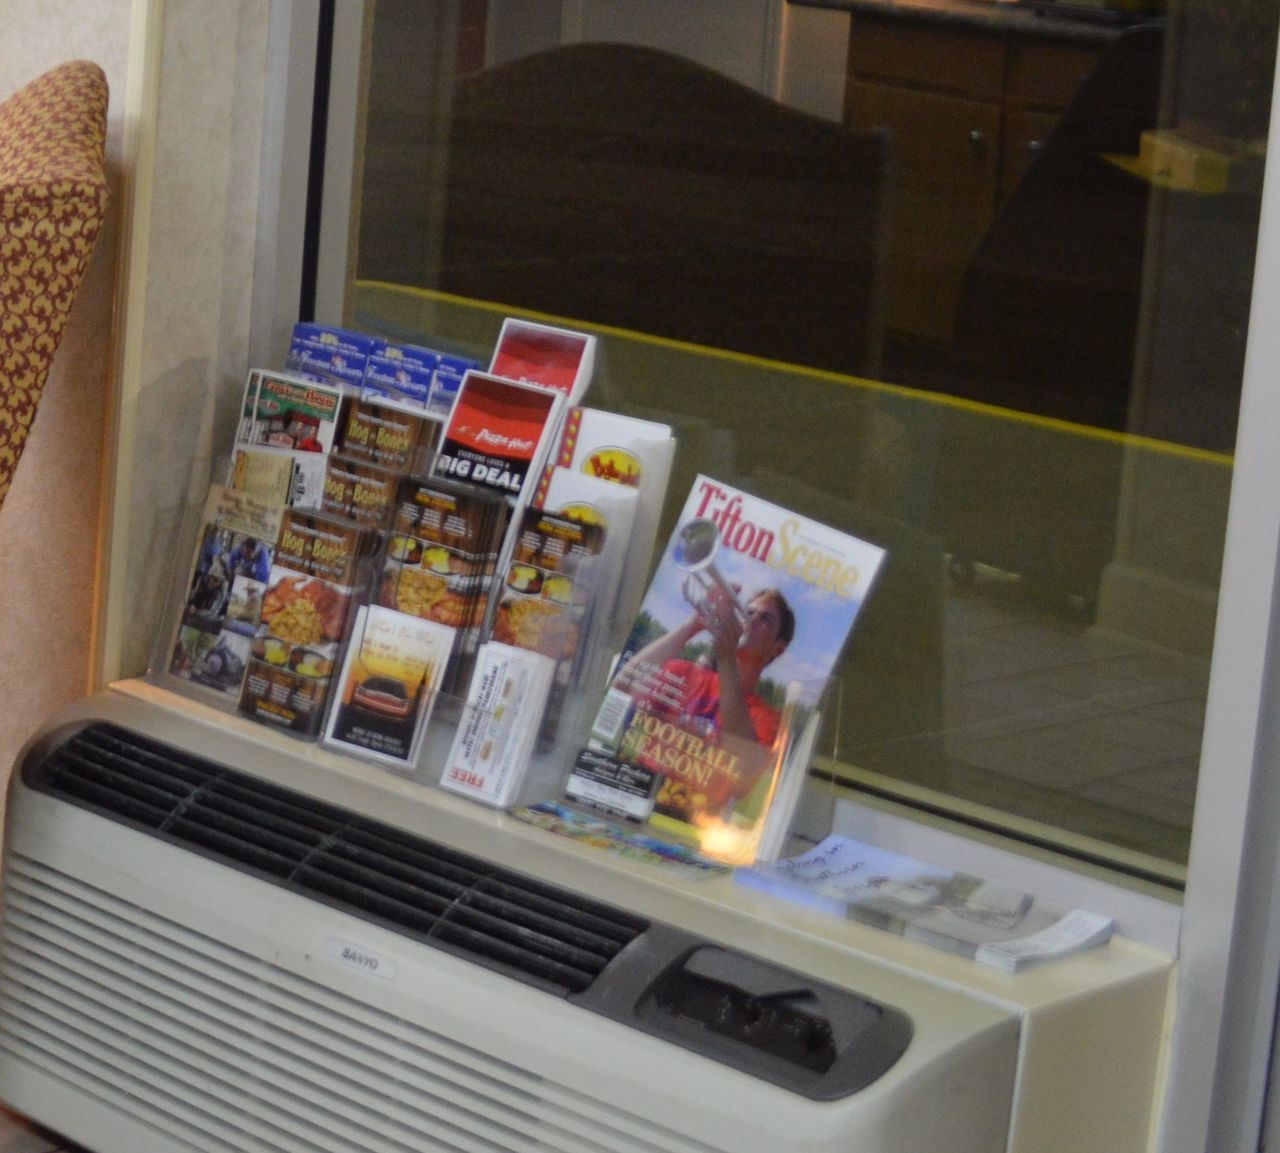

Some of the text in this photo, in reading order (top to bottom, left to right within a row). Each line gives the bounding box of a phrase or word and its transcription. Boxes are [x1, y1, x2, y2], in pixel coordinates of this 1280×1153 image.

[476, 428, 533, 451] Pizza Hut
[438, 454, 521, 493] BIG DEAL
[767, 518, 858, 597] Scene
[622, 728, 713, 786] SEASON!
[631, 708, 740, 778] FOOTBALL
[449, 766, 485, 790] FREE
